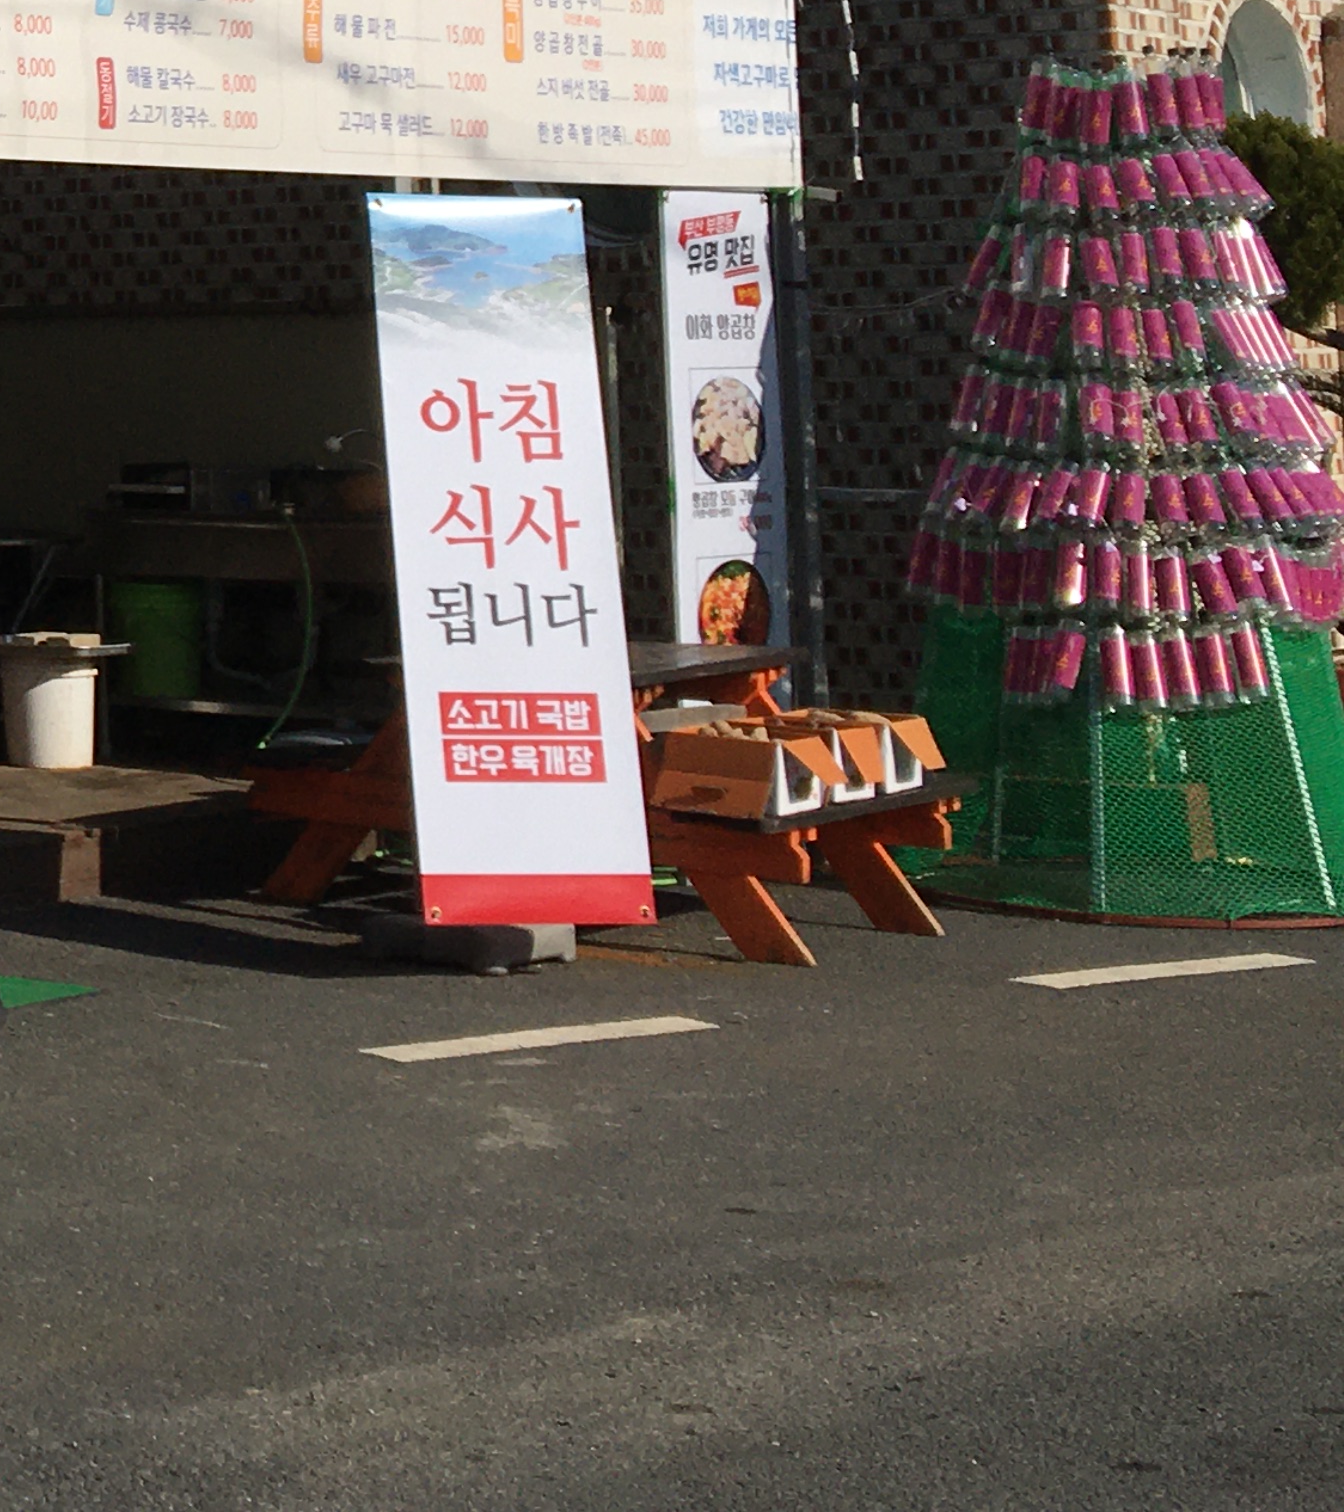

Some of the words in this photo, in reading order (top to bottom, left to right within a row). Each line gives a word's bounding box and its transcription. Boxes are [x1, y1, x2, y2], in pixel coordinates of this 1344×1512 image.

[13, 13, 53, 36] 8,000
[123, 10, 150, 33] 수제
[153, 12, 193, 37] 콩국수
[218, 18, 254, 41] 7,000
[445, 24, 485, 47] 15,000
[702, 13, 729, 40] 저희
[732, 15, 771, 42] 가게의
[631, 39, 667, 61] 30,000
[16, 56, 57, 78] 8,000
[126, 65, 154, 90] 해물
[156, 67, 196, 91] 칼국수
[221, 73, 257, 95] 8,000
[337, 62, 362, 85] 새우
[366, 64, 416, 90] 고구마전
[447, 71, 487, 93] 12,000
[713, 61, 791, 89] 자색고구마로
[99, 61, 114, 126] 동절기
[561, 77, 585, 101] 버섯
[587, 79, 611, 102] 전골
[633, 83, 669, 104] 30,000
[21, 99, 59, 123] 10,00
[127, 104, 167, 128] 소고기
[171, 105, 210, 129] 장국수
[223, 109, 258, 131] 8,000
[338, 111, 377, 135] 고구마
[380, 112, 393, 136] 묵
[396, 114, 434, 138] 샐러드
[450, 117, 489, 140] 12,000
[719, 108, 759, 136] 건강한
[634, 128, 671, 148] 45,000
[687, 240, 719, 276] 유명
[724, 234, 755, 269] 맛집
[685, 313, 713, 340] 이화
[716, 312, 756, 340] 양곱창
[419, 377, 564, 464] 아침
[429, 483, 581, 572] 식사
[426, 581, 599, 648] 됩니다
[447, 699, 529, 731] 소고기
[535, 699, 592, 731] 국밥
[450, 745, 507, 778] 한우
[511, 744, 594, 778] 육개장
